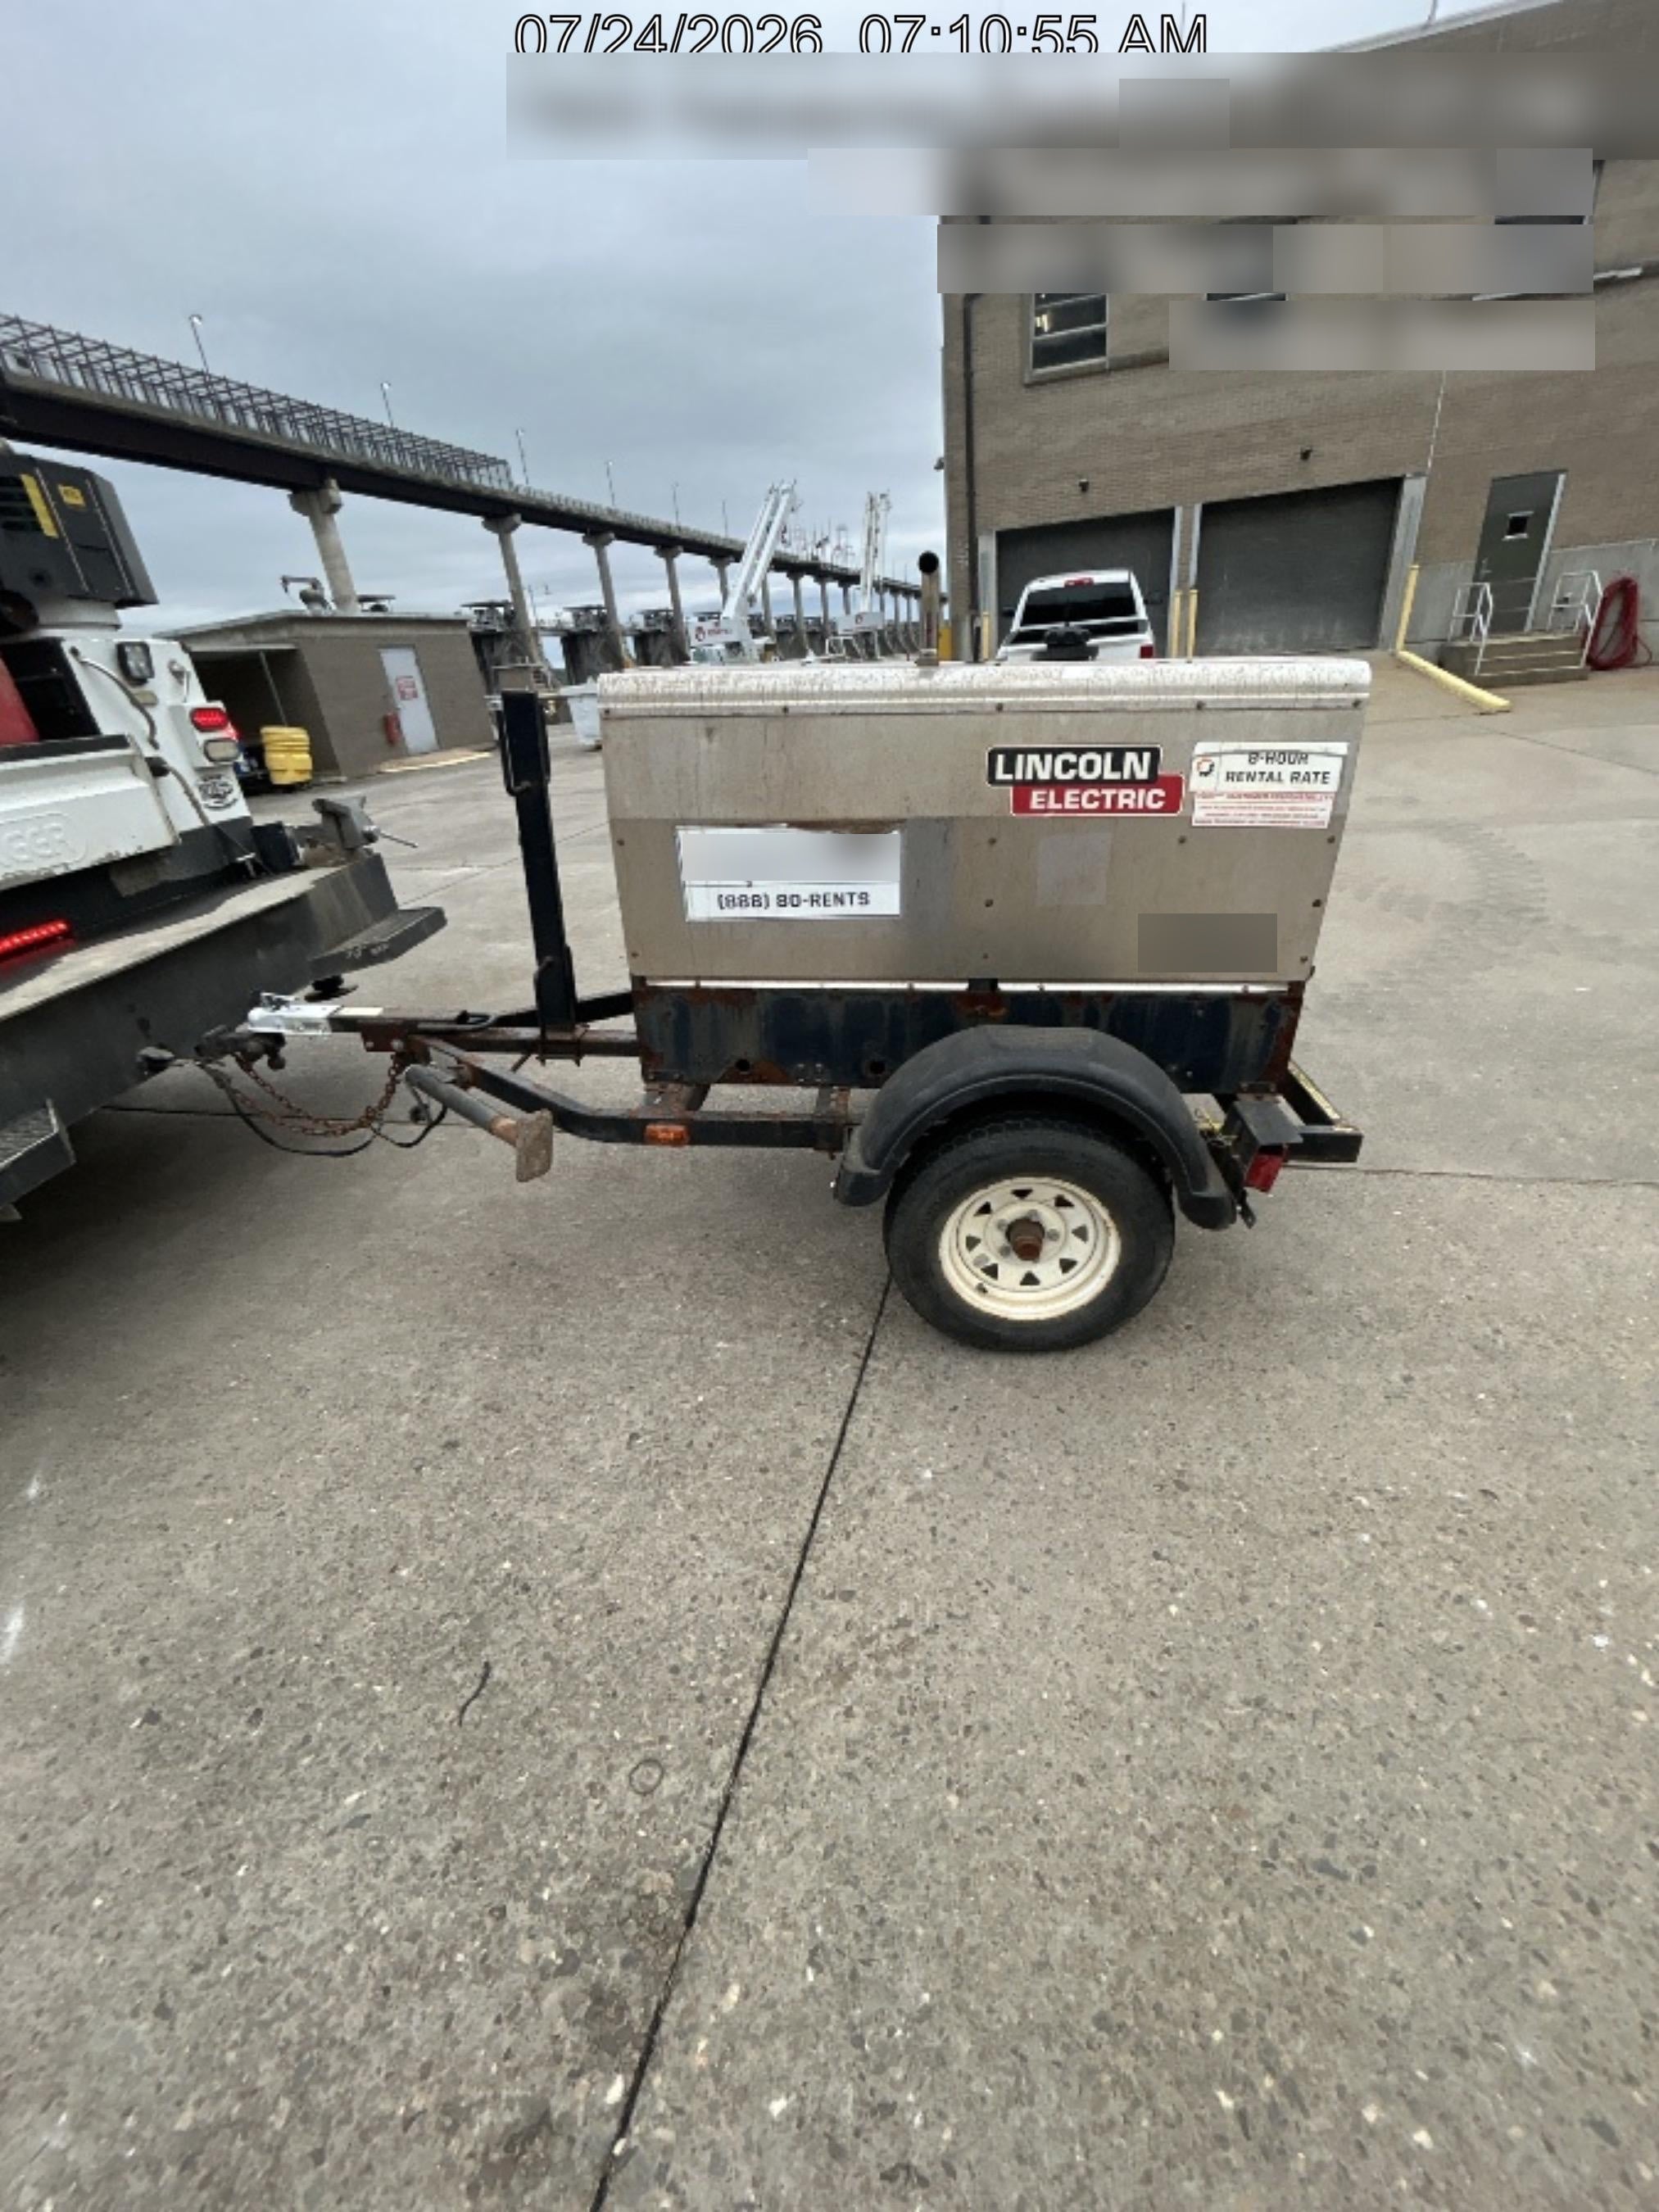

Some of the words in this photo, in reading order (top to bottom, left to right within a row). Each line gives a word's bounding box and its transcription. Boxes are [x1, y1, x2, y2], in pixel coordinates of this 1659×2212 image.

[995, 751, 1151, 781] LINCOLN
[1248, 751, 1308, 765] 8-HOUR
[1226, 771, 1284, 783] RENTAL
[1290, 771, 1331, 784] RATE
[1029, 788, 1166, 810] ELECTRIC
[718, 893, 770, 910] (888)
